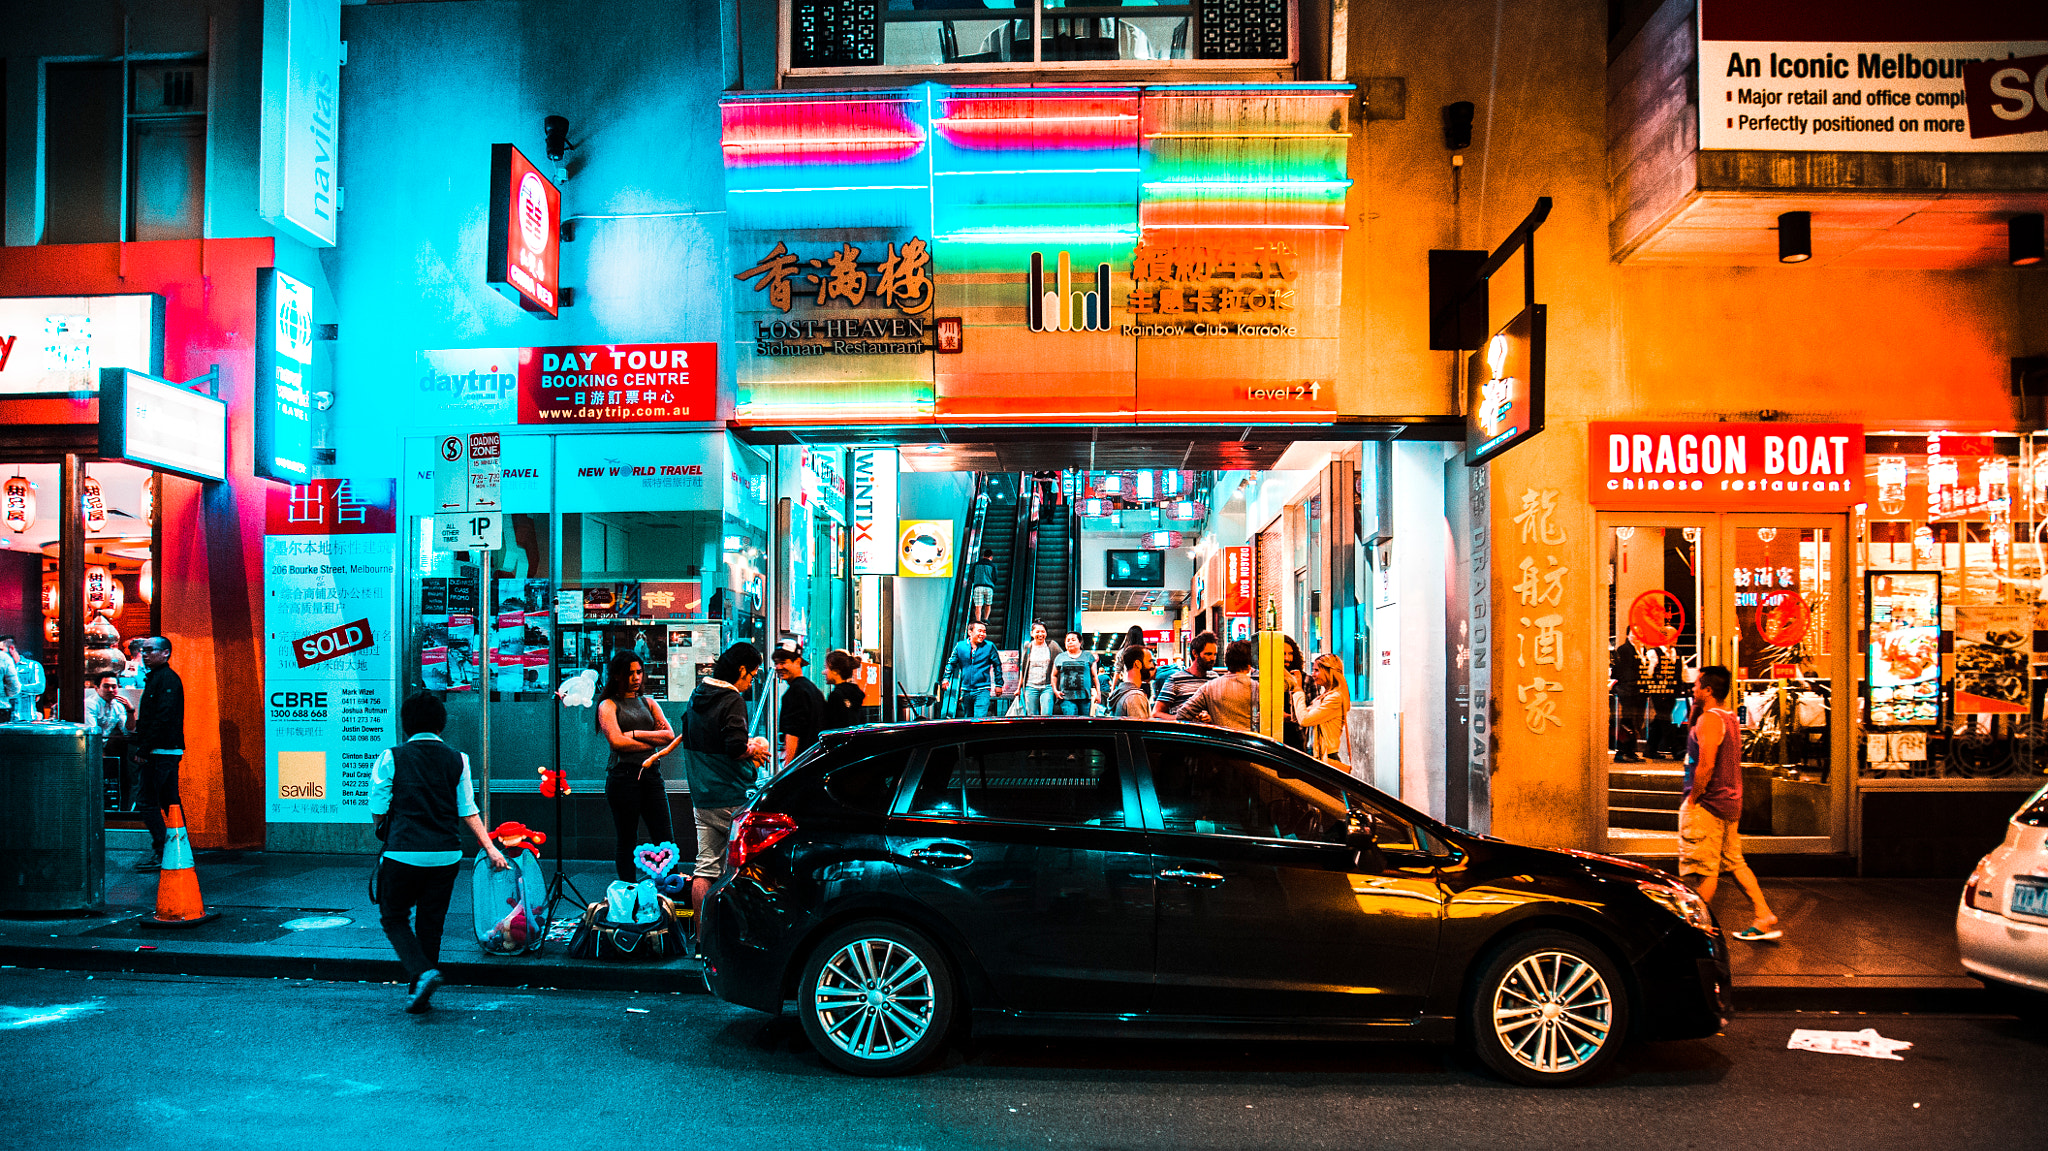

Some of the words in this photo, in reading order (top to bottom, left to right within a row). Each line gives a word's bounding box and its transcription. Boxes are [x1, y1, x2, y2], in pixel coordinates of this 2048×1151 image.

[1727, 53, 1761, 77] An
[1770, 53, 1849, 78] Iconic
[1857, 53, 1995, 79] Melbour
[1738, 89, 1782, 108] Major
[1787, 89, 1827, 104] retail
[1832, 90, 1861, 105] and
[1866, 89, 1911, 106] office
[1739, 115, 1807, 134] Perfectly
[1813, 116, 1894, 134] positioned
[1900, 120, 1918, 132] on
[1924, 120, 1965, 132] more
[313, 70, 332, 222] navitas
[755, 319, 818, 340] LOST
[826, 318, 926, 339] HEAVEN
[1122, 324, 1185, 337] Rainbow
[1194, 323, 1228, 337] Club
[1237, 324, 1297, 337] Karaoke
[757, 342, 823, 356] Sichuan
[834, 340, 923, 355] Restaurant
[543, 352, 598, 372] DAY
[610, 350, 689, 370] TOUR
[419, 365, 516, 398] daytrip
[541, 374, 618, 389] BOOKING
[623, 372, 690, 387] CENTRE
[1248, 386, 1289, 401] Level
[1295, 386, 1305, 401] 2
[479, 402, 500, 410] Agent
[538, 405, 690, 419] www.daytrip.com.au
[470, 436, 500, 447] LOADING
[472, 446, 498, 456] ZONE
[1609, 434, 1746, 474] DRAGON
[1765, 436, 1849, 475] BOAT
[500, 468, 539, 478] RAVEL
[578, 467, 605, 477] NEW
[660, 465, 703, 475] TRAVEL
[1607, 478, 1703, 491] chinese
[1721, 479, 1851, 492] restaurant
[288, 479, 373, 524] 出售
[469, 517, 490, 535] 1P
[272, 565, 287, 574] 206
[289, 565, 318, 574] Bourke
[321, 565, 348, 576] Street,
[350, 564, 394, 574] Melbourne
[1240, 548, 1250, 577] DRAGON
[1240, 579, 1250, 598] BOAT
[1473, 526, 1488, 669] DRAGON
[1513, 487, 1568, 735] 龍舫酒家
[302, 626, 363, 660] SOLD
[270, 692, 328, 708] CBRE
[271, 709, 290, 718] 1300
[292, 709, 308, 718] 688
[310, 709, 328, 718] 668
[1472, 689, 1487, 781] BOAT
[281, 782, 324, 798] savills
